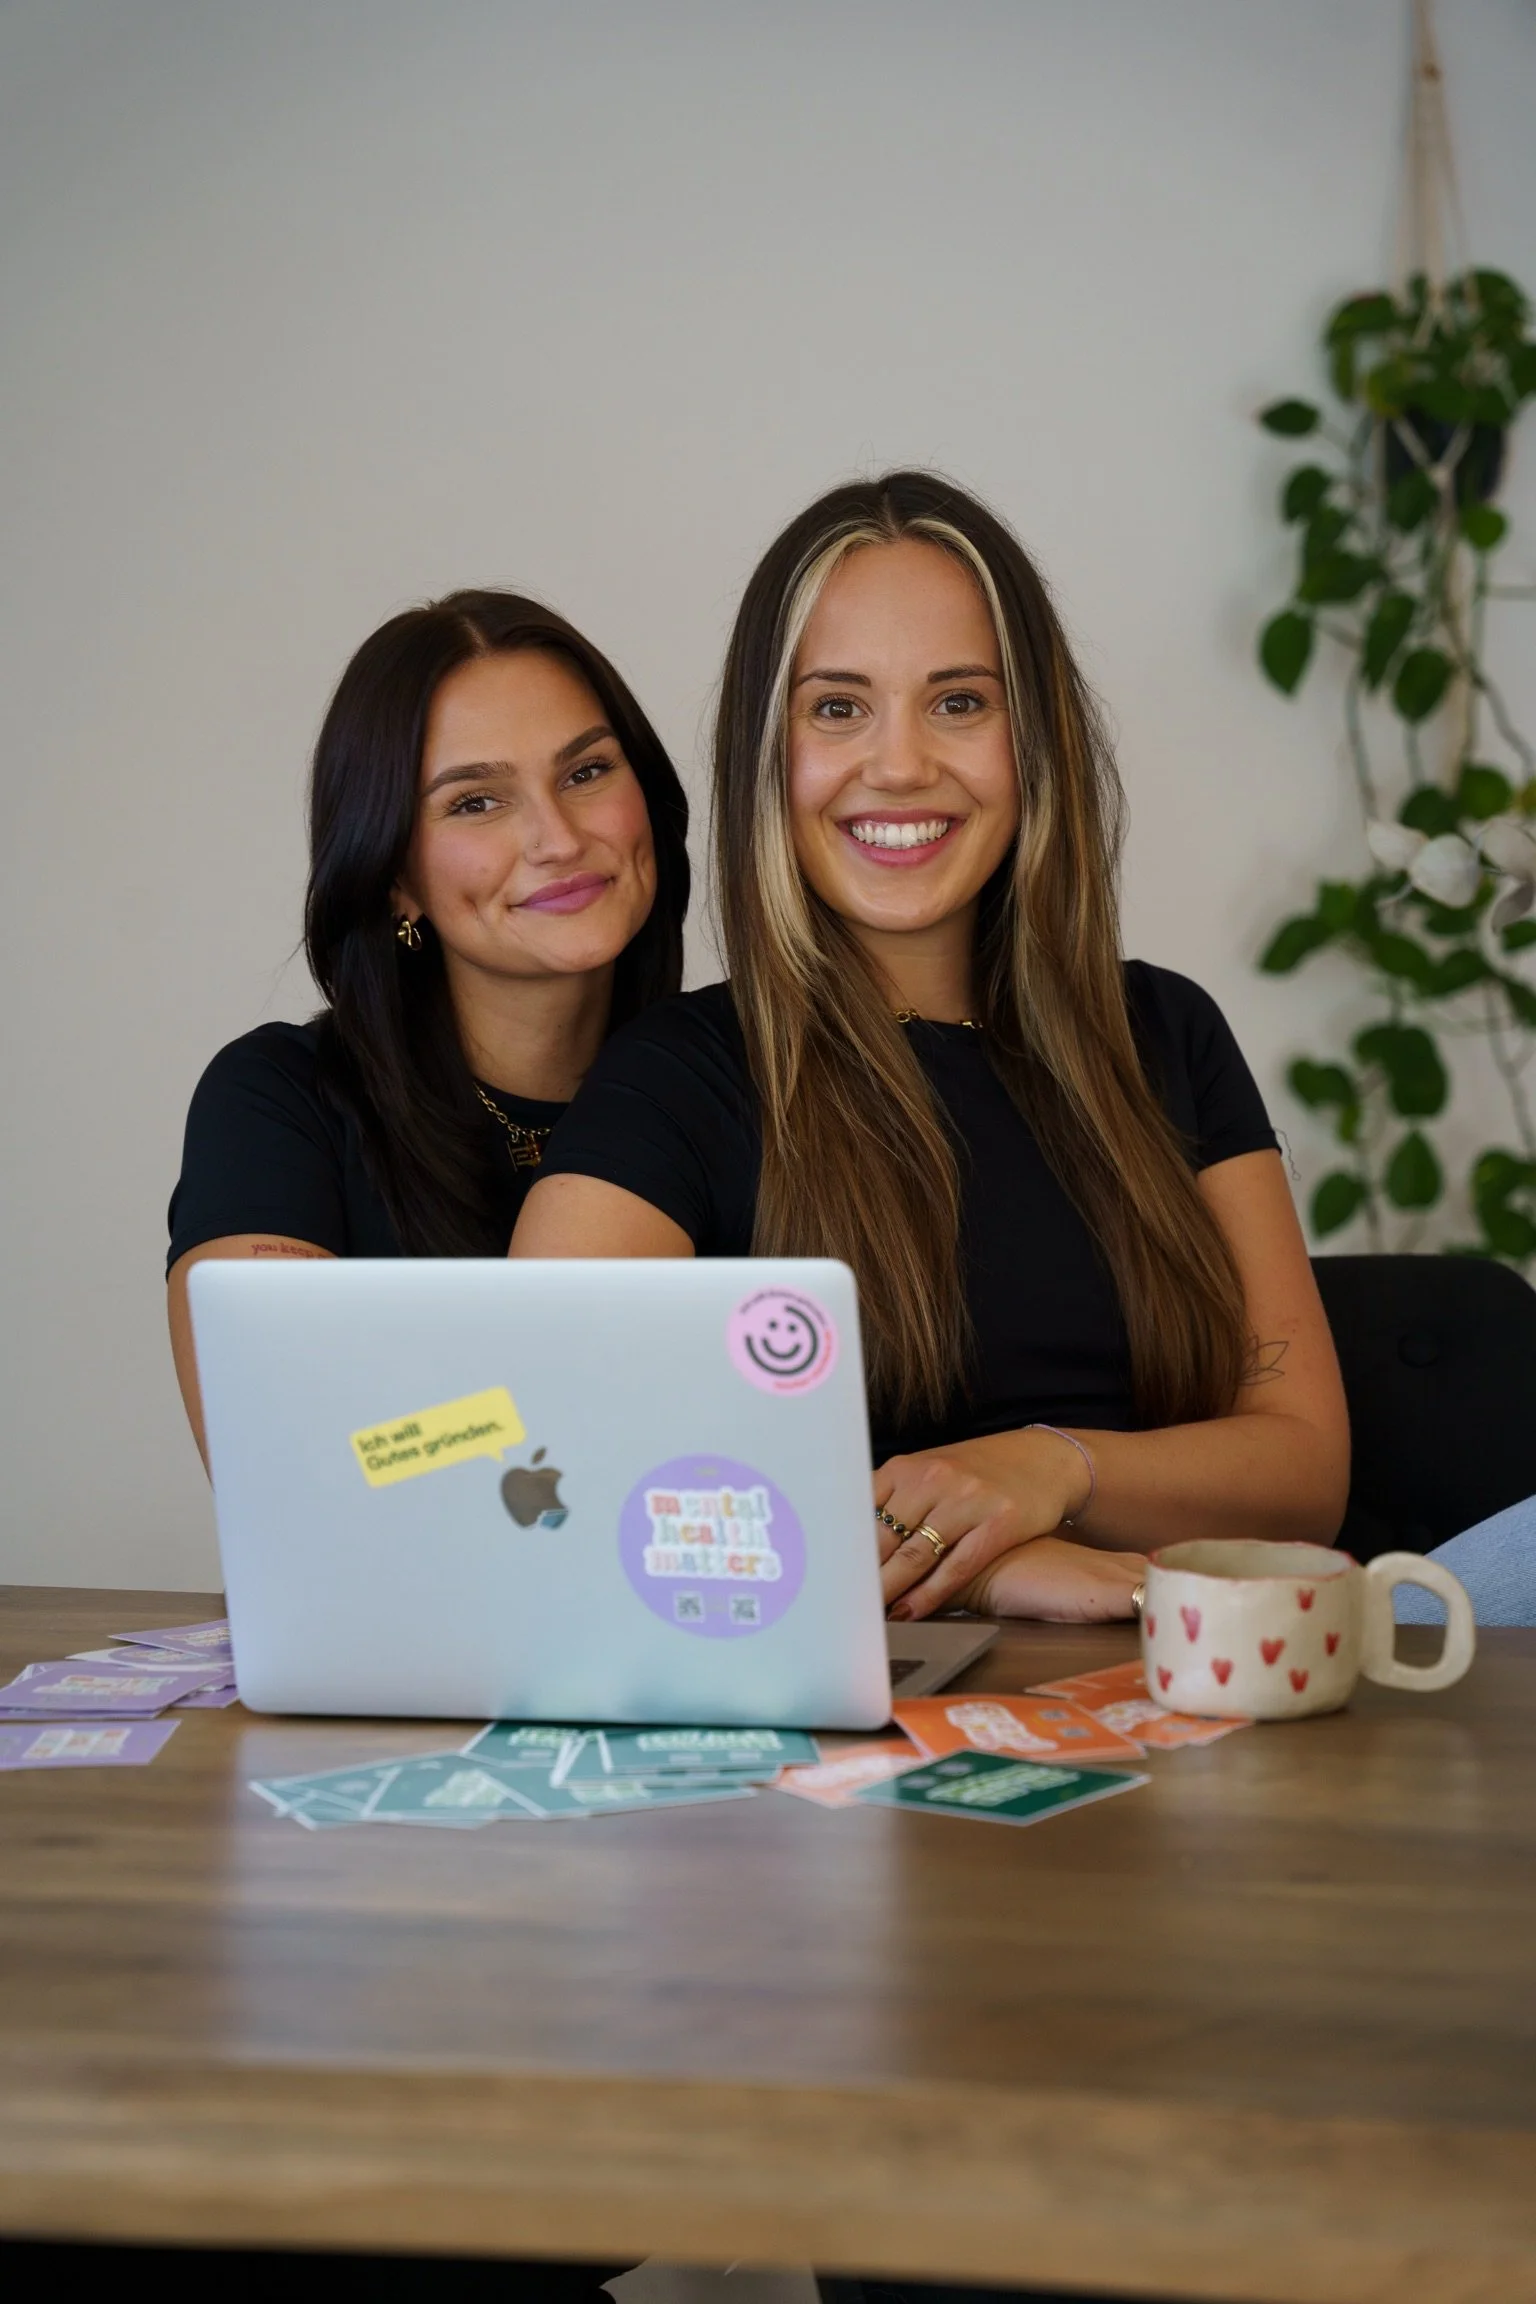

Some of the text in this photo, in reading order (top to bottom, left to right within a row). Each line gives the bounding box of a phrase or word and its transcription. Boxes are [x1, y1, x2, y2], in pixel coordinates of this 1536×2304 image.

[251, 1243, 278, 1256] you
[280, 1243, 315, 1258] keep
[357, 1422, 423, 1453] Ich will
[366, 1446, 420, 1471] Gutes
[651, 1490, 767, 1521] mental
[658, 1514, 767, 1548] health
[650, 1549, 779, 1578] matters
